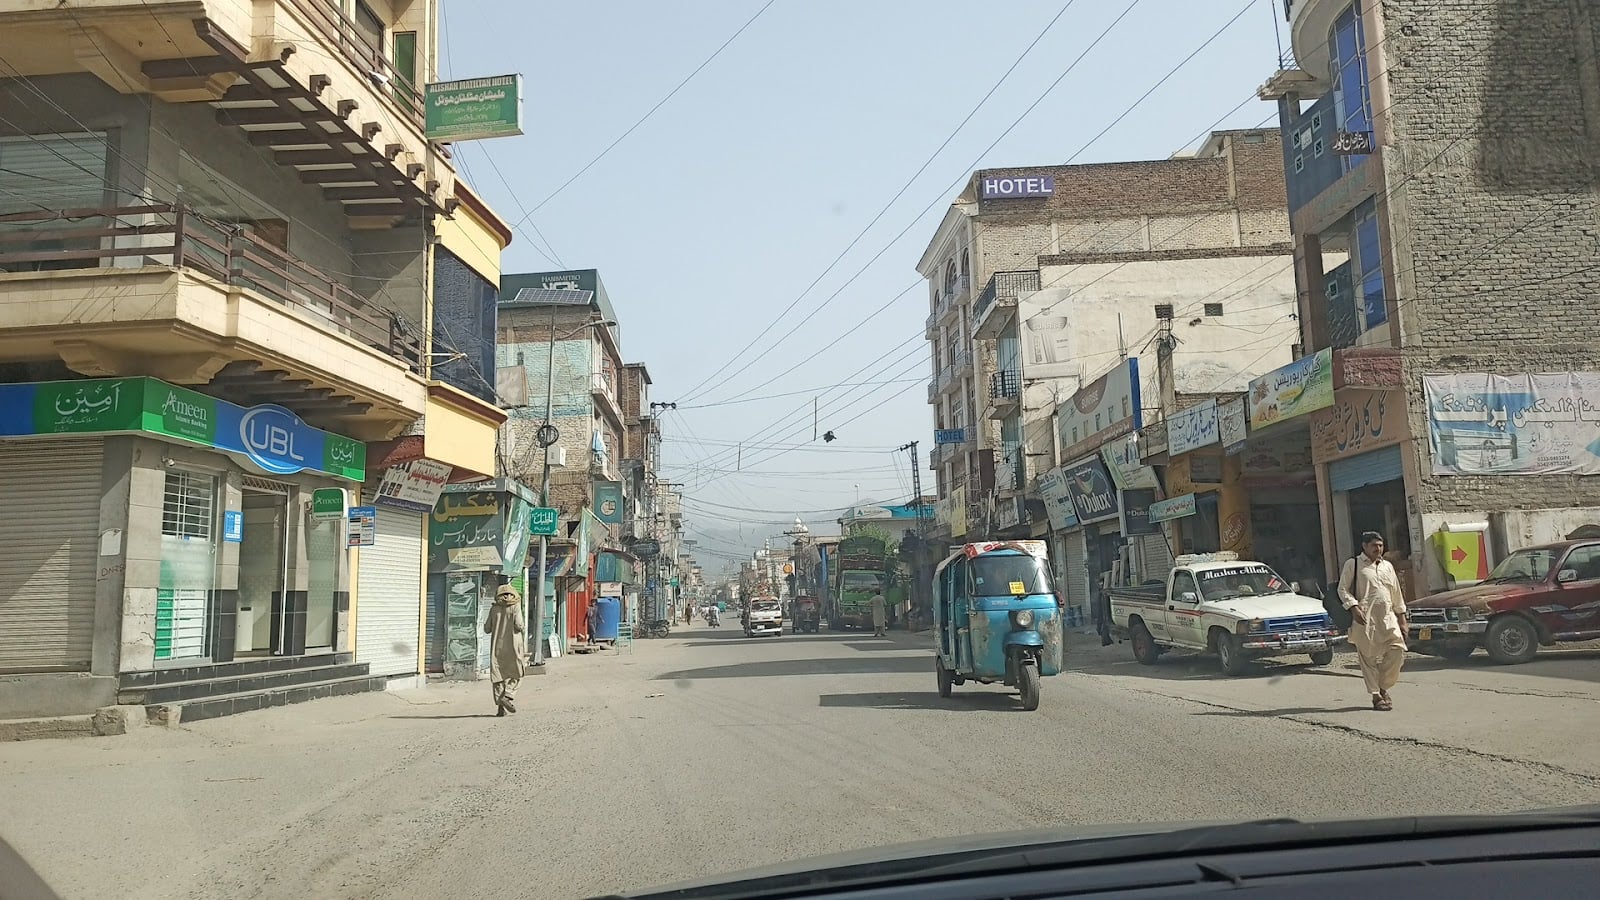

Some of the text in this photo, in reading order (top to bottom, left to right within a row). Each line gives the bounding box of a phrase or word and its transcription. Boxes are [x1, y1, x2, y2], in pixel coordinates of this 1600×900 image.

[492, 76, 513, 87] HOTEL
[985, 178, 1052, 194] HOTEL
[162, 390, 208, 421] Ameen
[250, 419, 304, 461] UBL
[937, 430, 964, 440] HOTEL
[434, 493, 499, 522] شکیل
[1081, 491, 1111, 514] Dulux
[1203, 566, 1269, 581] Masha Allah
